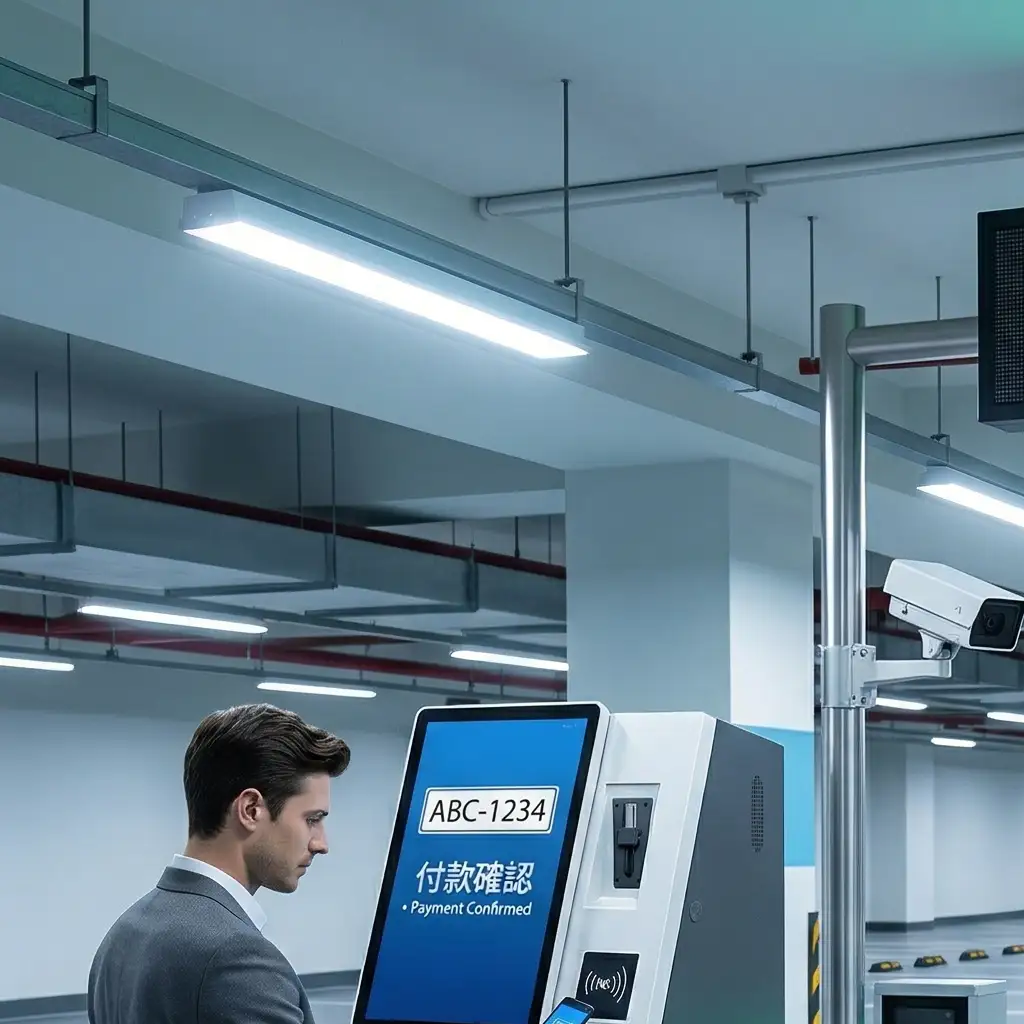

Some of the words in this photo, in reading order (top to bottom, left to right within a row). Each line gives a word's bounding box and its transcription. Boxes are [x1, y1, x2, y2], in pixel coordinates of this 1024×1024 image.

[428, 798, 546, 823] ABC-1234
[416, 860, 535, 895] 付款確認
[410, 900, 464, 918] Payment
[466, 900, 533, 916] Confirmed
